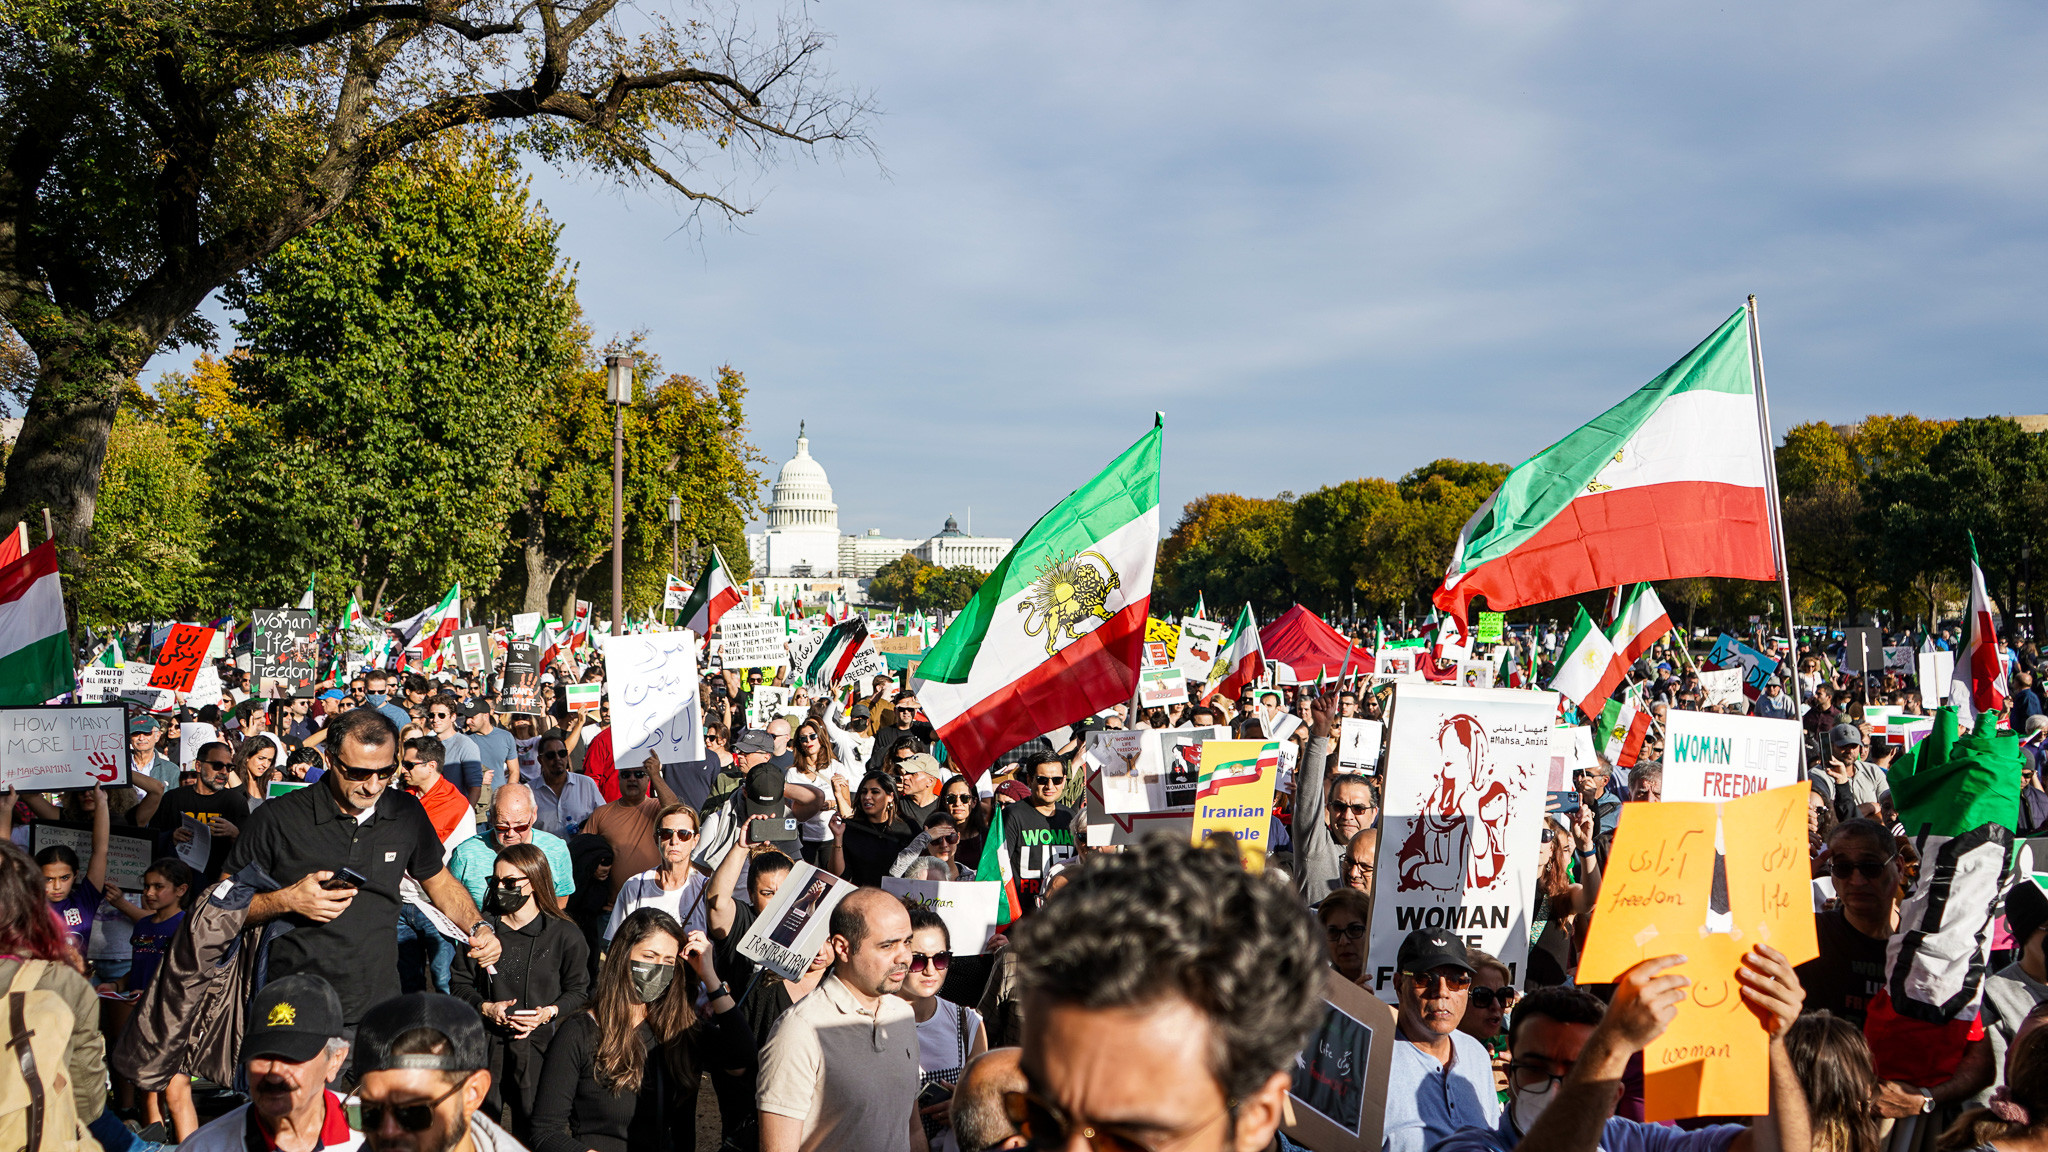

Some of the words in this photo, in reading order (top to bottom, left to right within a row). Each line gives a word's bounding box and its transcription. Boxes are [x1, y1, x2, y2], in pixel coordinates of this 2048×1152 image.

[253, 610, 311, 629] Woman
[724, 622, 752, 632] IRANIAN
[754, 620, 779, 629] WOMEN
[176, 627, 203, 646] زن
[743, 630, 760, 638] NEED
[761, 628, 775, 636] YOU
[254, 630, 292, 654] Life
[512, 643, 530, 651] YOUR
[742, 638, 760, 647] THEM
[761, 635, 778, 645] THEY
[725, 647, 741, 655] NEED
[742, 646, 755, 654] YOU
[756, 645, 764, 653] TO
[724, 655, 745, 663] SAVING
[763, 652, 786, 661] KILLERS
[852, 657, 869, 669] LIFE
[253, 656, 314, 681] Freedom
[844, 662, 878, 682] FREEDOM
[97, 677, 117, 685] IRAN'S
[150, 666, 195, 690] آزادی
[86, 693, 103, 701] THEIR
[509, 687, 534, 697] IRAN'S
[521, 698, 536, 707] LIFE
[13, 716, 58, 732] HOW
[70, 715, 112, 731] MANY
[7, 736, 64, 755] MORE
[72, 732, 124, 752] LIVES?
[1490, 736, 1548, 747] #Mahsa_Amini
[1673, 733, 1732, 765] WOMAN
[1744, 737, 1789, 773] LIFE
[6, 763, 72, 778] #MAHSAAMINI
[1202, 804, 1265, 818] Iranian
[41, 828, 69, 837] GIRLS
[1201, 827, 1260, 842] Pple
[40, 838, 65, 846] GIRLS
[1629, 829, 1704, 879] آزادی
[121, 860, 147, 868] WORLD
[110, 868, 145, 877] KINDNES
[1608, 883, 1685, 914] freedom
[1761, 883, 1791, 920] life
[1396, 905, 1510, 931] WOMAN
[1319, 1039, 1334, 1059] life
[1662, 1044, 1731, 1065] woman
